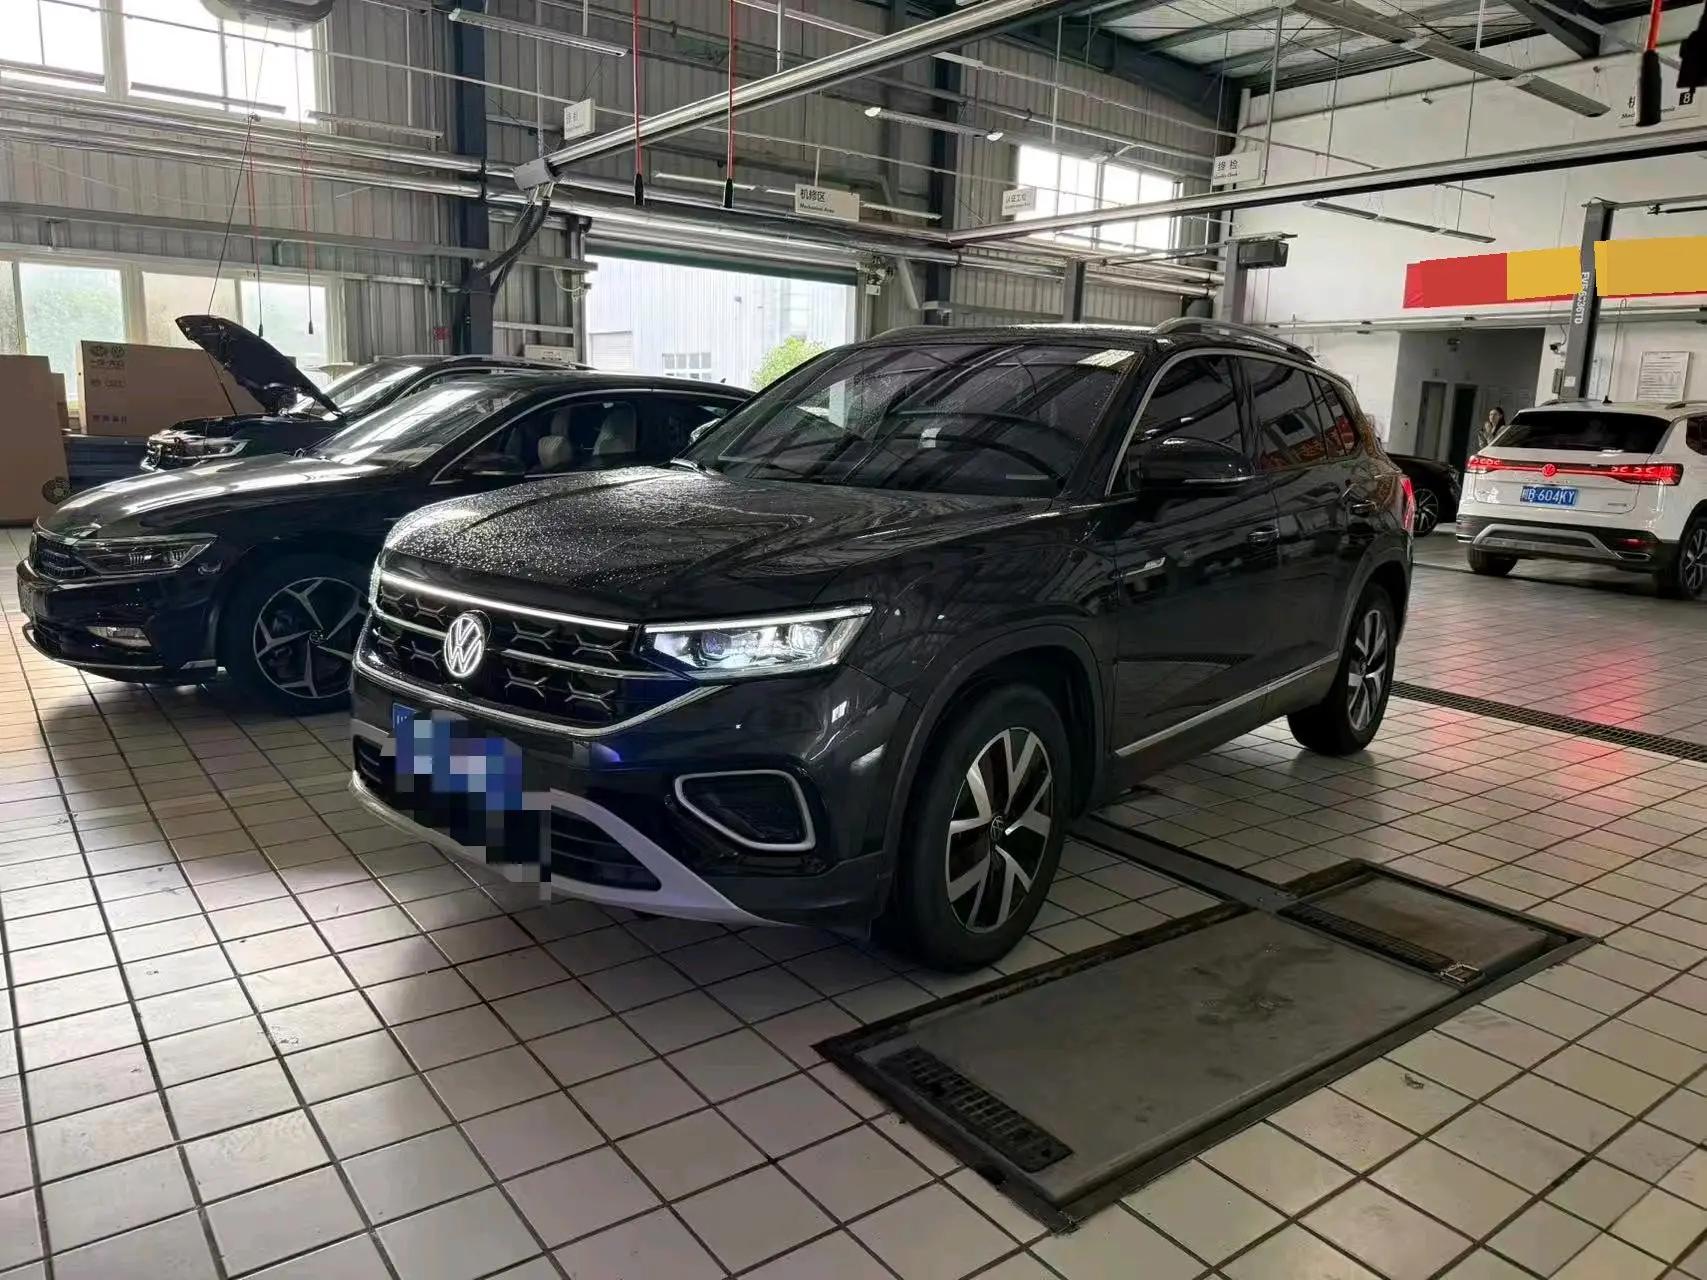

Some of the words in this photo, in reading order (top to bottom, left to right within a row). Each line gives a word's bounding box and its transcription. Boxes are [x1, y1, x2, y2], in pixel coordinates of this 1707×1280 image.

[801, 189, 825, 202] 机修区
[444, 613, 485, 678] VW
